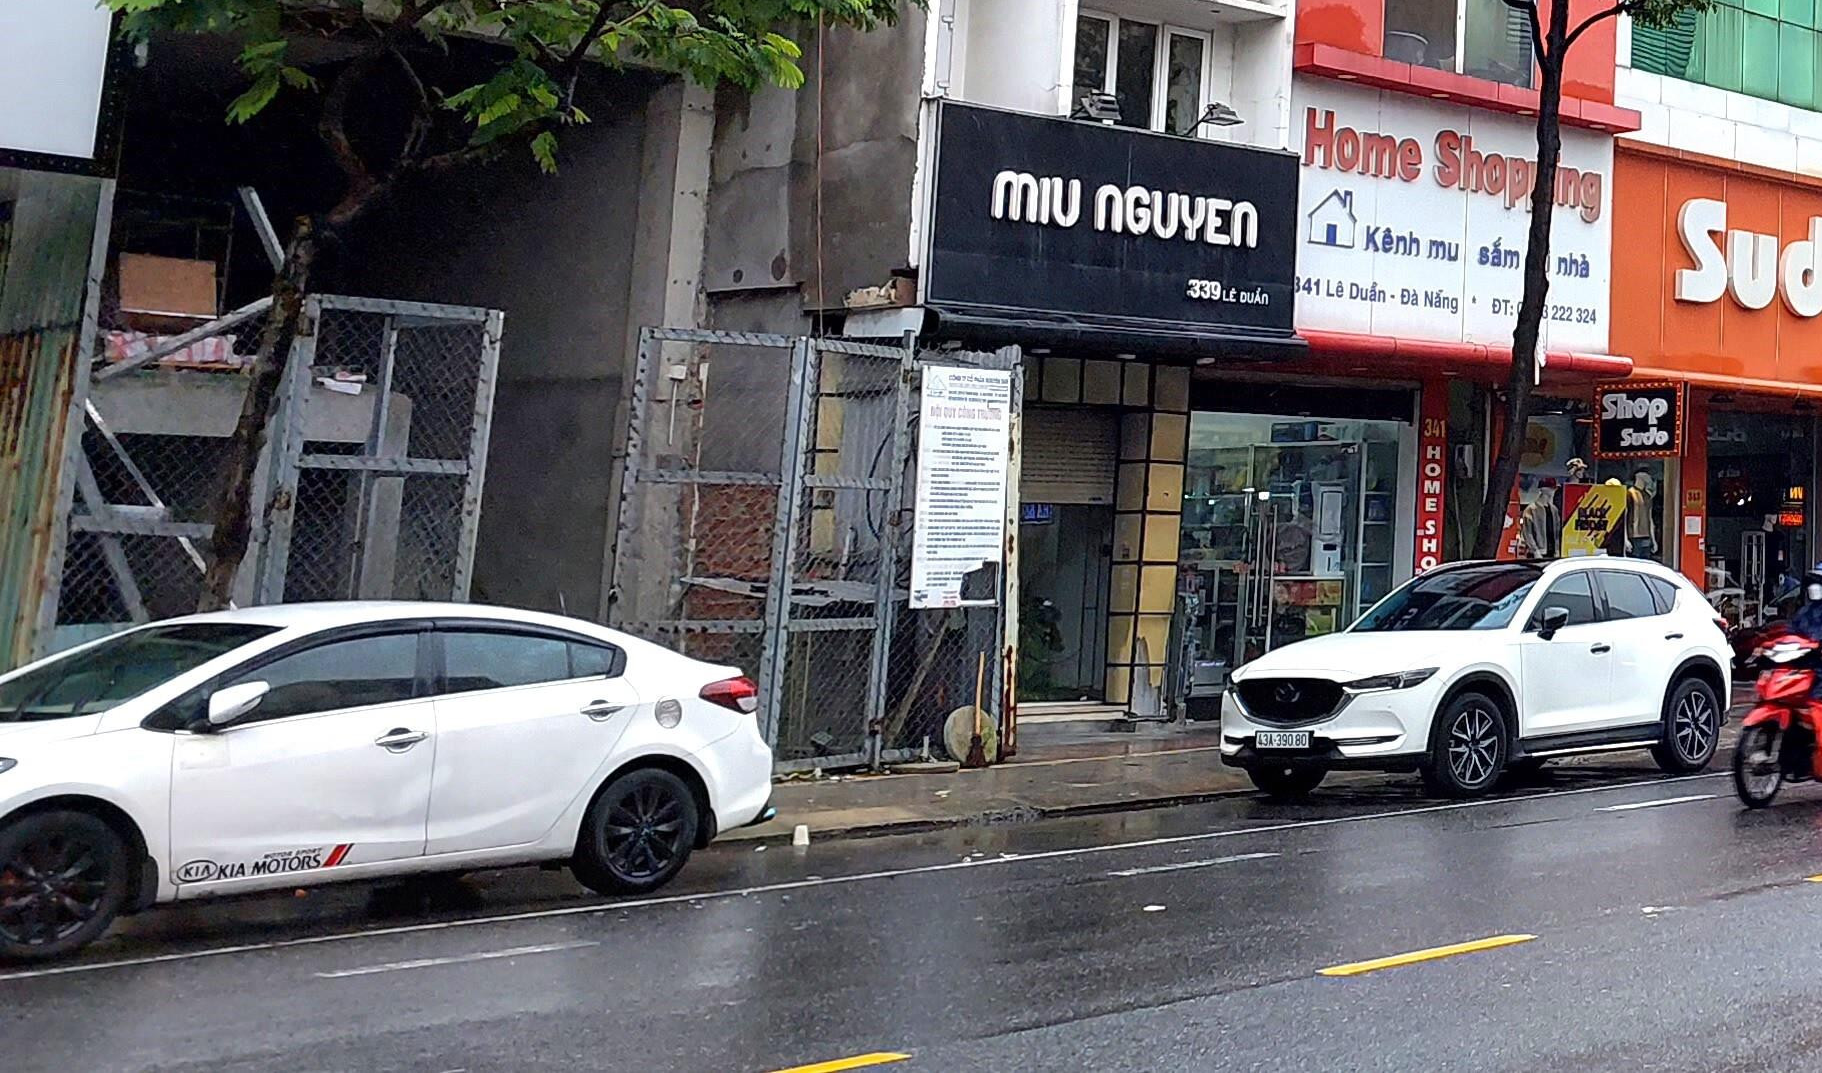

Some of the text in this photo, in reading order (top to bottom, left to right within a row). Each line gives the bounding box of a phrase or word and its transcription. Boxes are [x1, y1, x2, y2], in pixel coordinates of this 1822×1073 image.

[1301, 106, 1423, 183] Home
[991, 170, 1259, 249] MIU NGUYEN
[1364, 224, 1420, 257] Kênh
[1478, 236, 1520, 269] sắm
[1556, 251, 1591, 279] nhà
[1186, 277, 1270, 306] 339 LÊ DUẨN
[1325, 279, 1344, 299] Lê
[1349, 281, 1386, 305] Duẩn
[1400, 284, 1419, 307] Đà
[1424, 288, 1459, 314] Nẵng
[1551, 304, 1573, 323] 222
[1575, 307, 1597, 326] 324
[1602, 393, 1669, 425] Shop
[1424, 417, 1447, 439] 341
[1620, 426, 1670, 447] Sudo
[1423, 445, 1442, 512] HOME
[183, 864, 211, 878] KIA
[216, 853, 322, 880] KIA MOTORS
